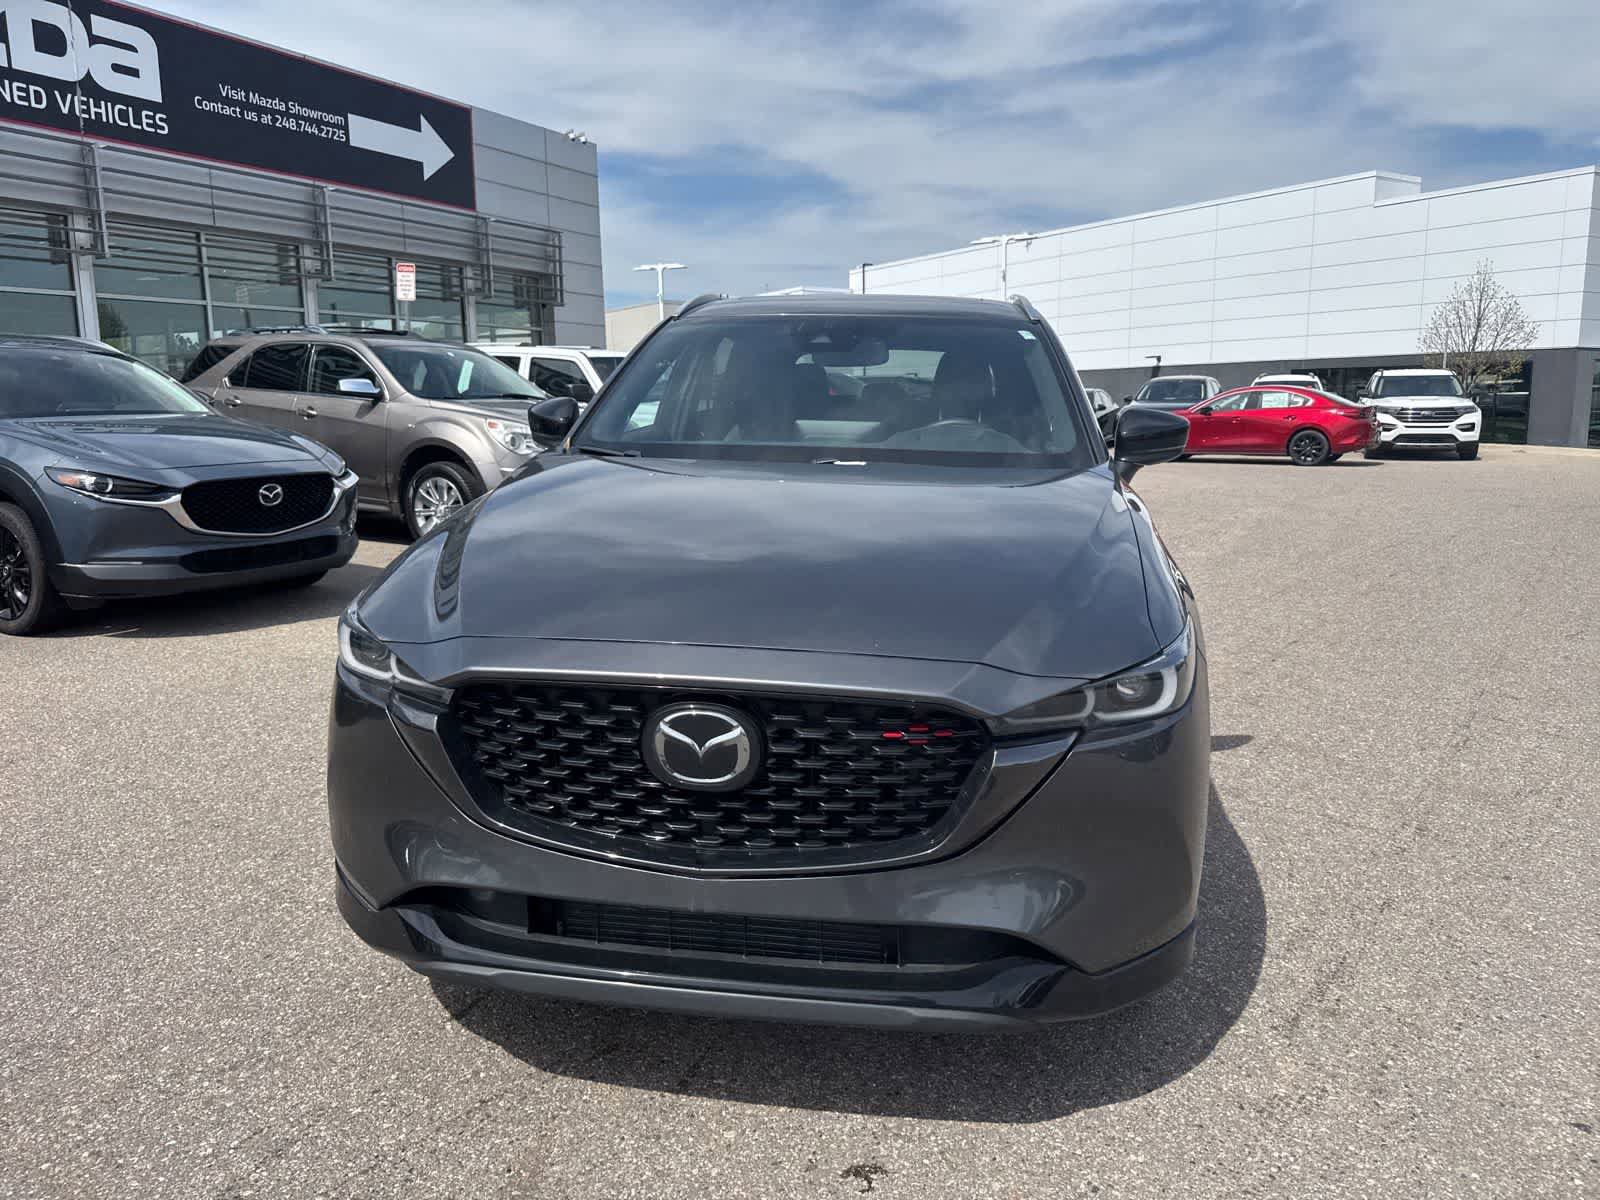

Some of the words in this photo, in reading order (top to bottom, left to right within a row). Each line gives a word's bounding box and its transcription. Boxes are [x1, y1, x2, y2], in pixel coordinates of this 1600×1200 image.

[54, 90, 169, 135] VEHICLES
[194, 96, 241, 118] Contact
[244, 110, 258, 122] us
[261, 113, 272, 125] at
[275, 115, 347, 142] 248.744.2725
[219, 83, 246, 102] Visit
[249, 91, 286, 112] Mazda
[288, 101, 345, 126] Showroom
